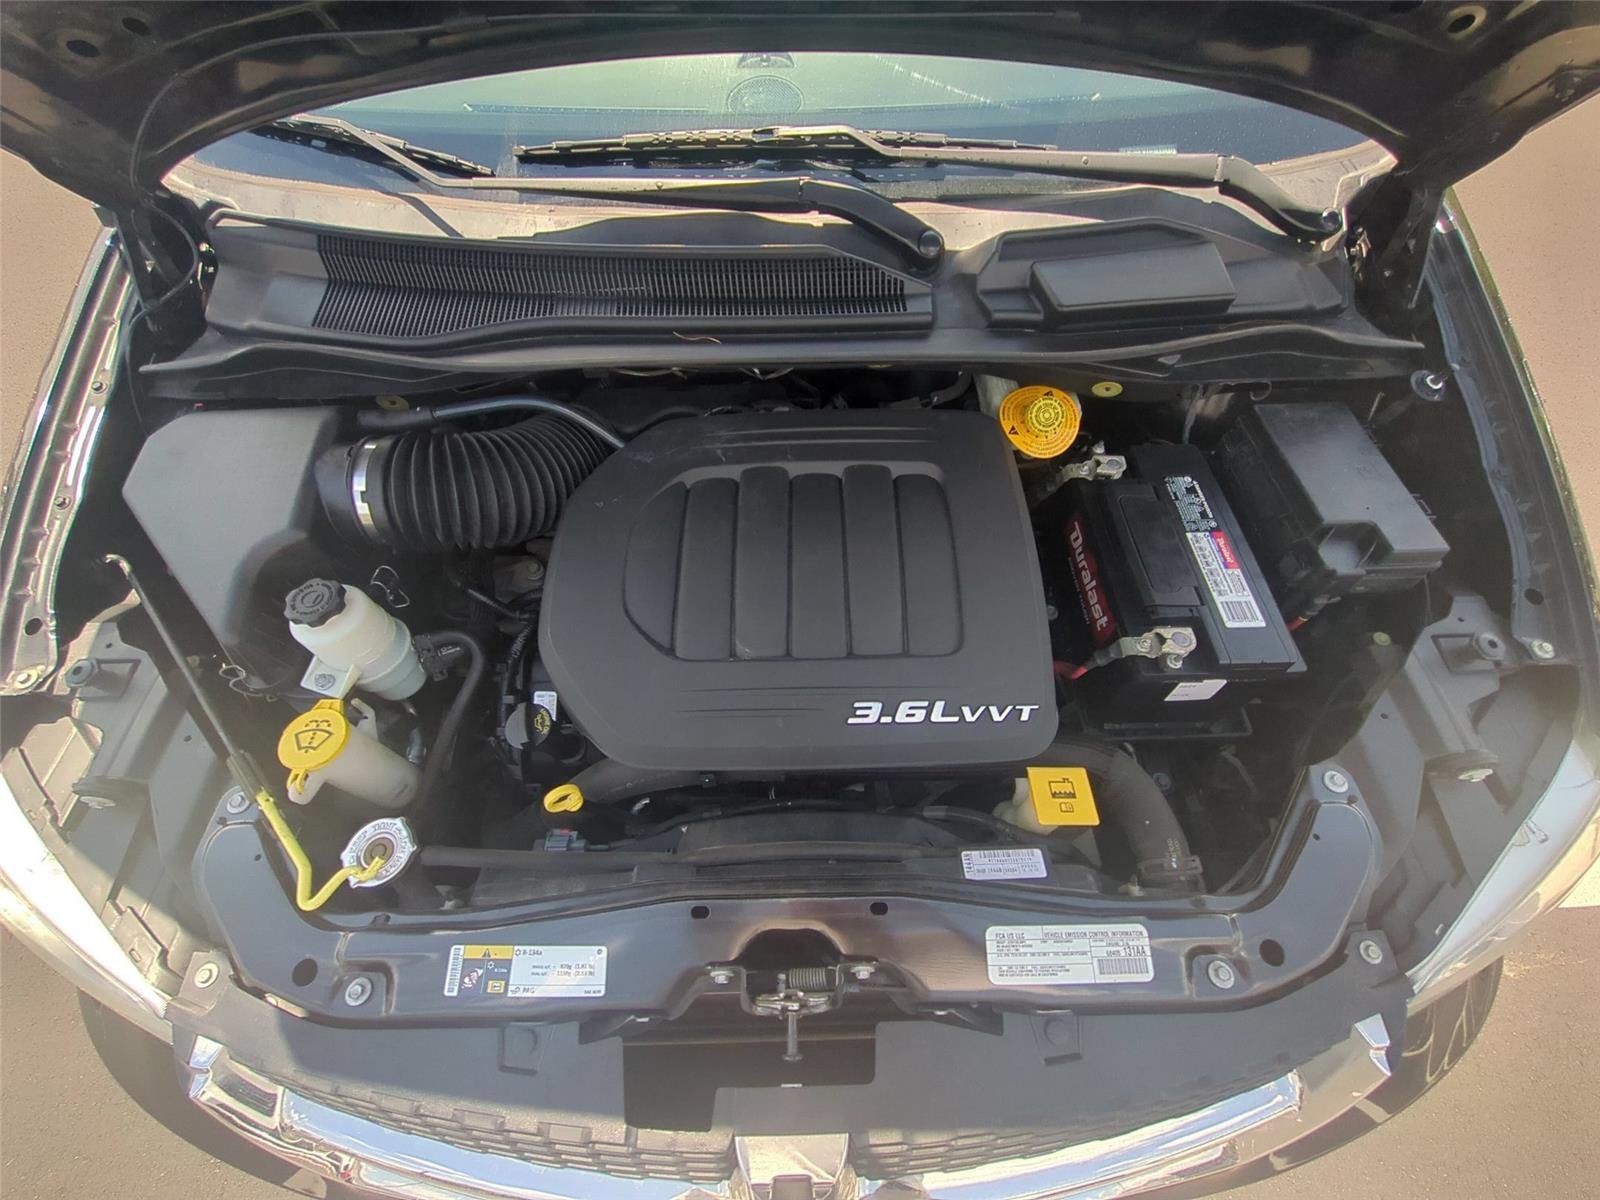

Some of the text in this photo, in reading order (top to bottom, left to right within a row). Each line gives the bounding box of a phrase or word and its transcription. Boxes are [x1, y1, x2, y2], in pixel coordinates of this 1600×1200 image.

[1070, 521, 1108, 632] Duralast
[1065, 931, 1088, 939] EMISSION
[1122, 945, 1147, 956] 131AA
